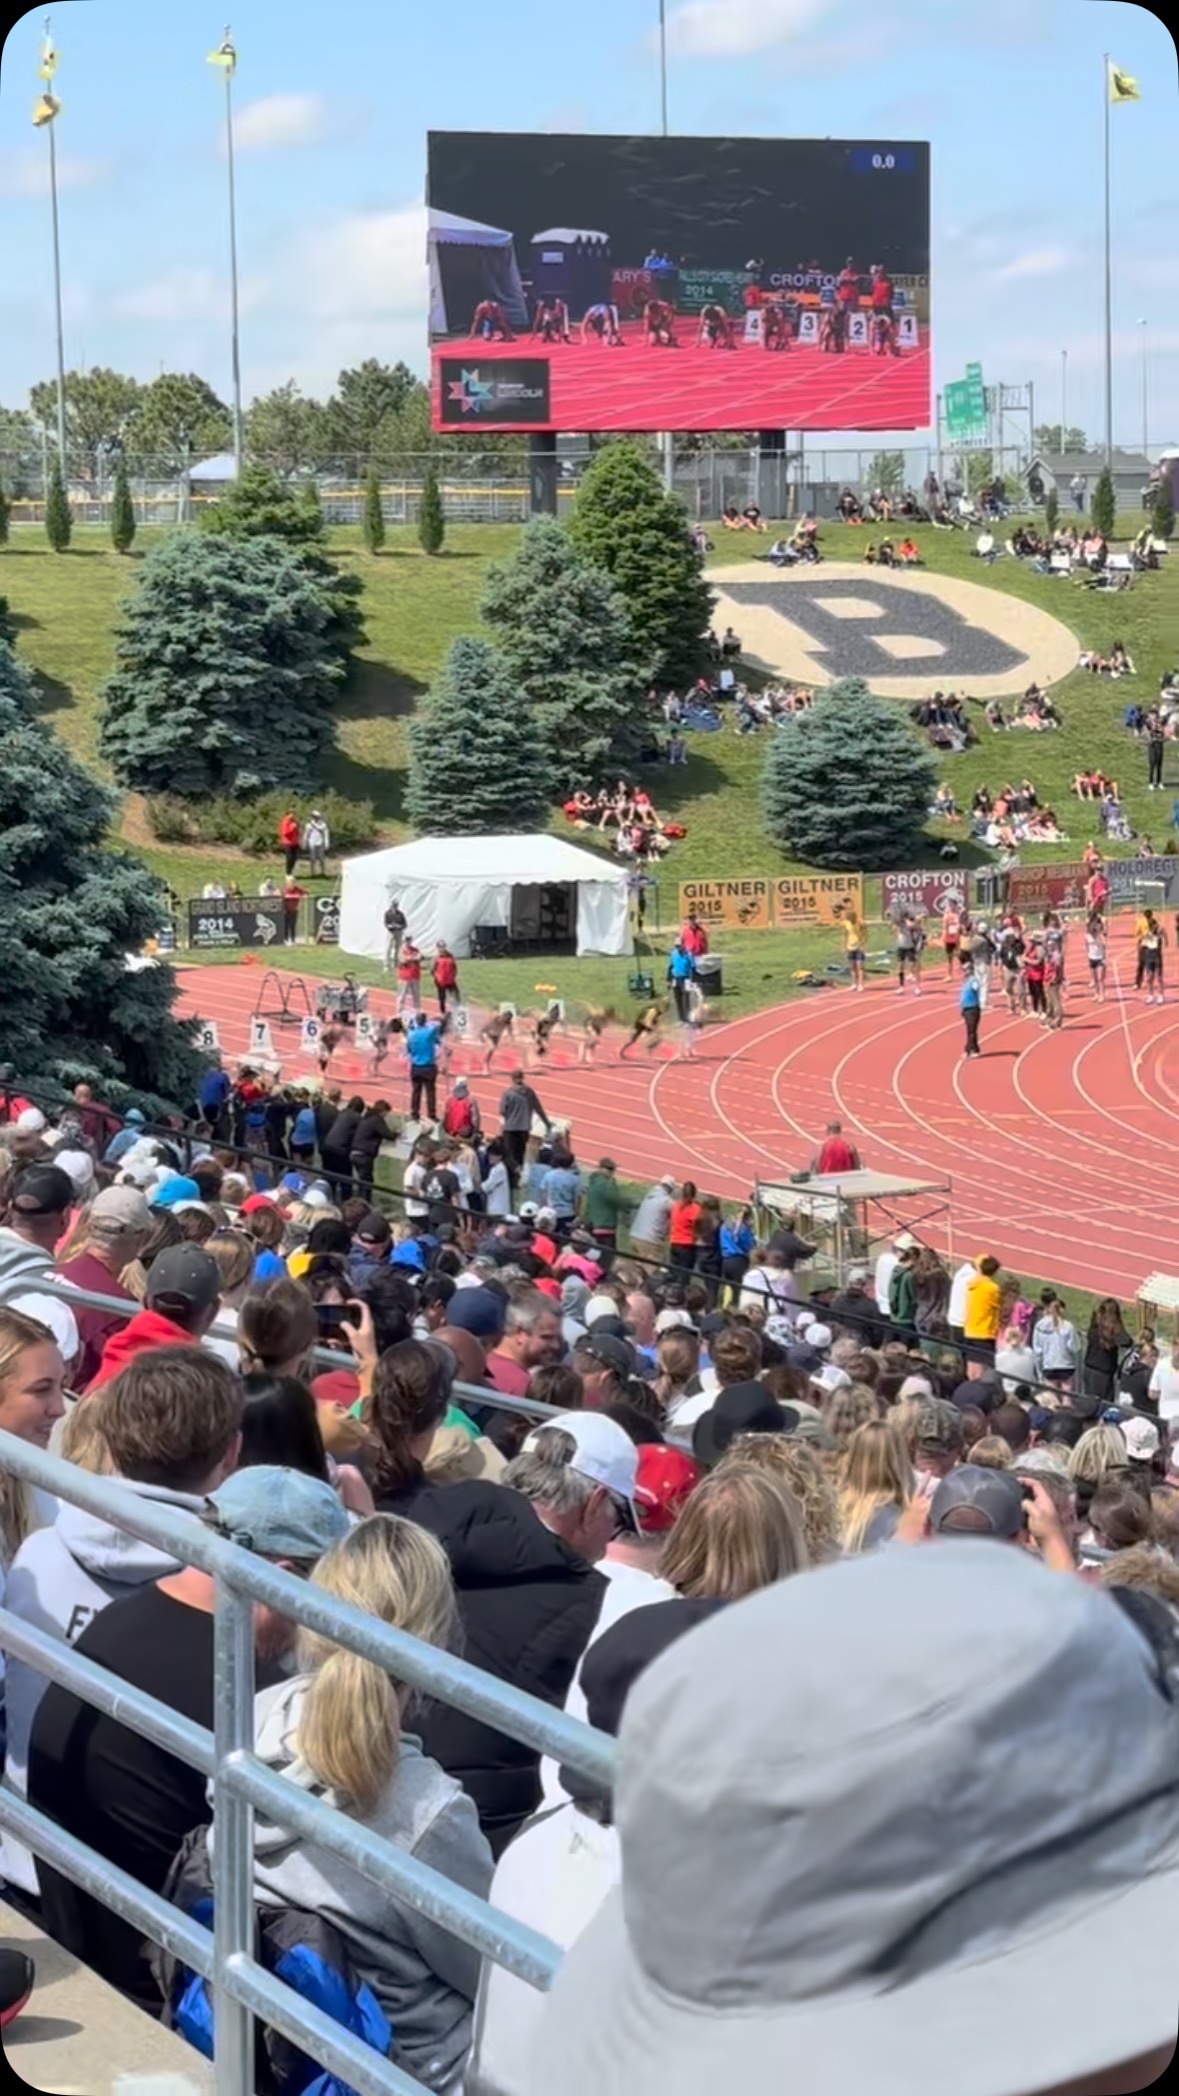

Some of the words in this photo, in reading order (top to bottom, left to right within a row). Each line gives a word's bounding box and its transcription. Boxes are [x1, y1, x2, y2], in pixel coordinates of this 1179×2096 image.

[872, 153, 895, 169] 0.0
[750, 318, 759, 330] 4
[804, 316, 814, 330] 3
[853, 320, 864, 336] 2
[904, 318, 912, 333] 1
[714, 578, 1030, 677] B
[778, 877, 859, 895] GILTNER
[885, 872, 965, 889] CROFTON
[683, 881, 766, 898] GILTNER
[890, 891, 924, 903] 2015
[688, 900, 722, 914] 2015
[783, 896, 817, 911] 2015
[198, 917, 234, 931] 2014
[360, 1018, 370, 1034] 5
[457, 1012, 467, 1028] 3
[255, 1023, 266, 1040] 7
[306, 1021, 318, 1037] 6
[203, 1031, 214, 1045] 8
